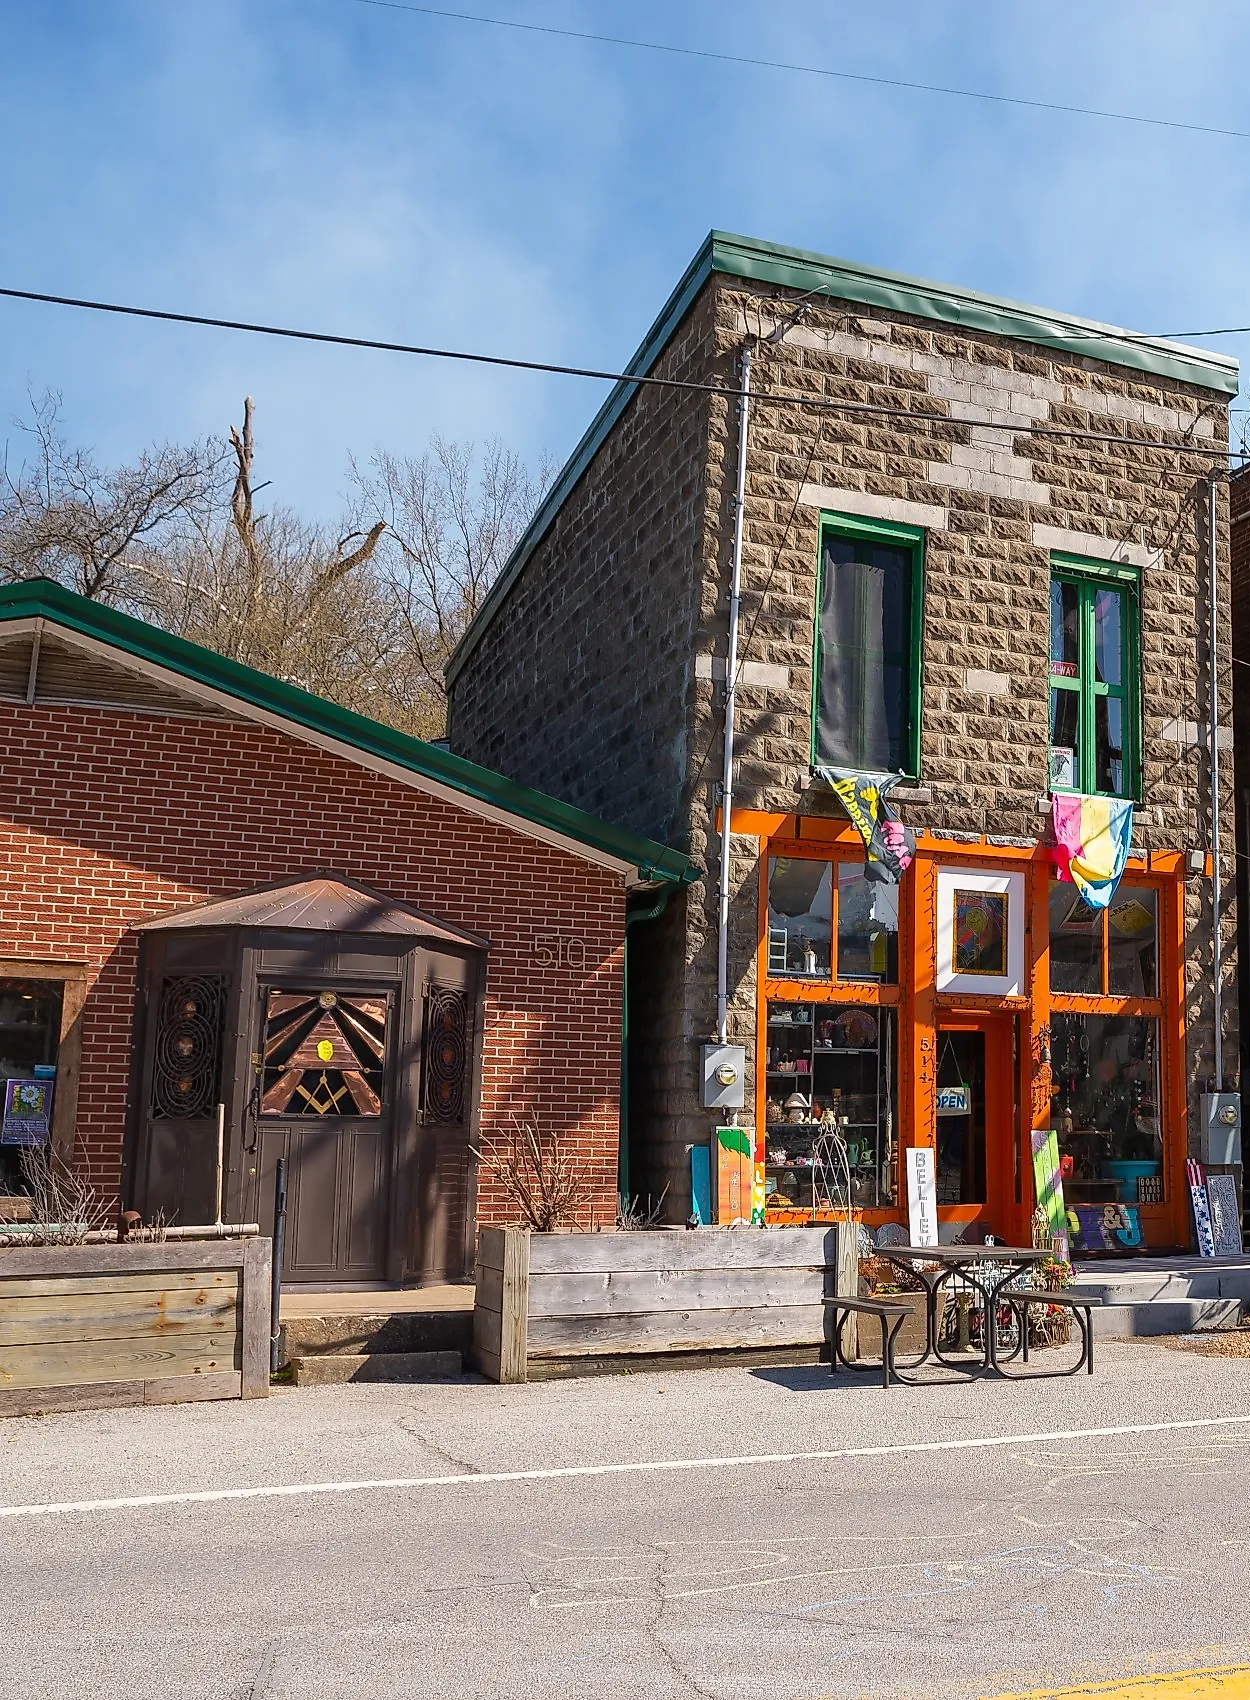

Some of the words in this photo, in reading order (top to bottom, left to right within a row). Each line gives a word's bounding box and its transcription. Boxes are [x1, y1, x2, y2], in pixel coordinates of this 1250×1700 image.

[534, 935, 586, 967] 510
[1140, 1178, 1161, 1187] GOOD
[1140, 1186, 1161, 1194] VIBES
[915, 1152, 932, 1247] BELIEV
[1141, 1193, 1161, 1203] ONLY
